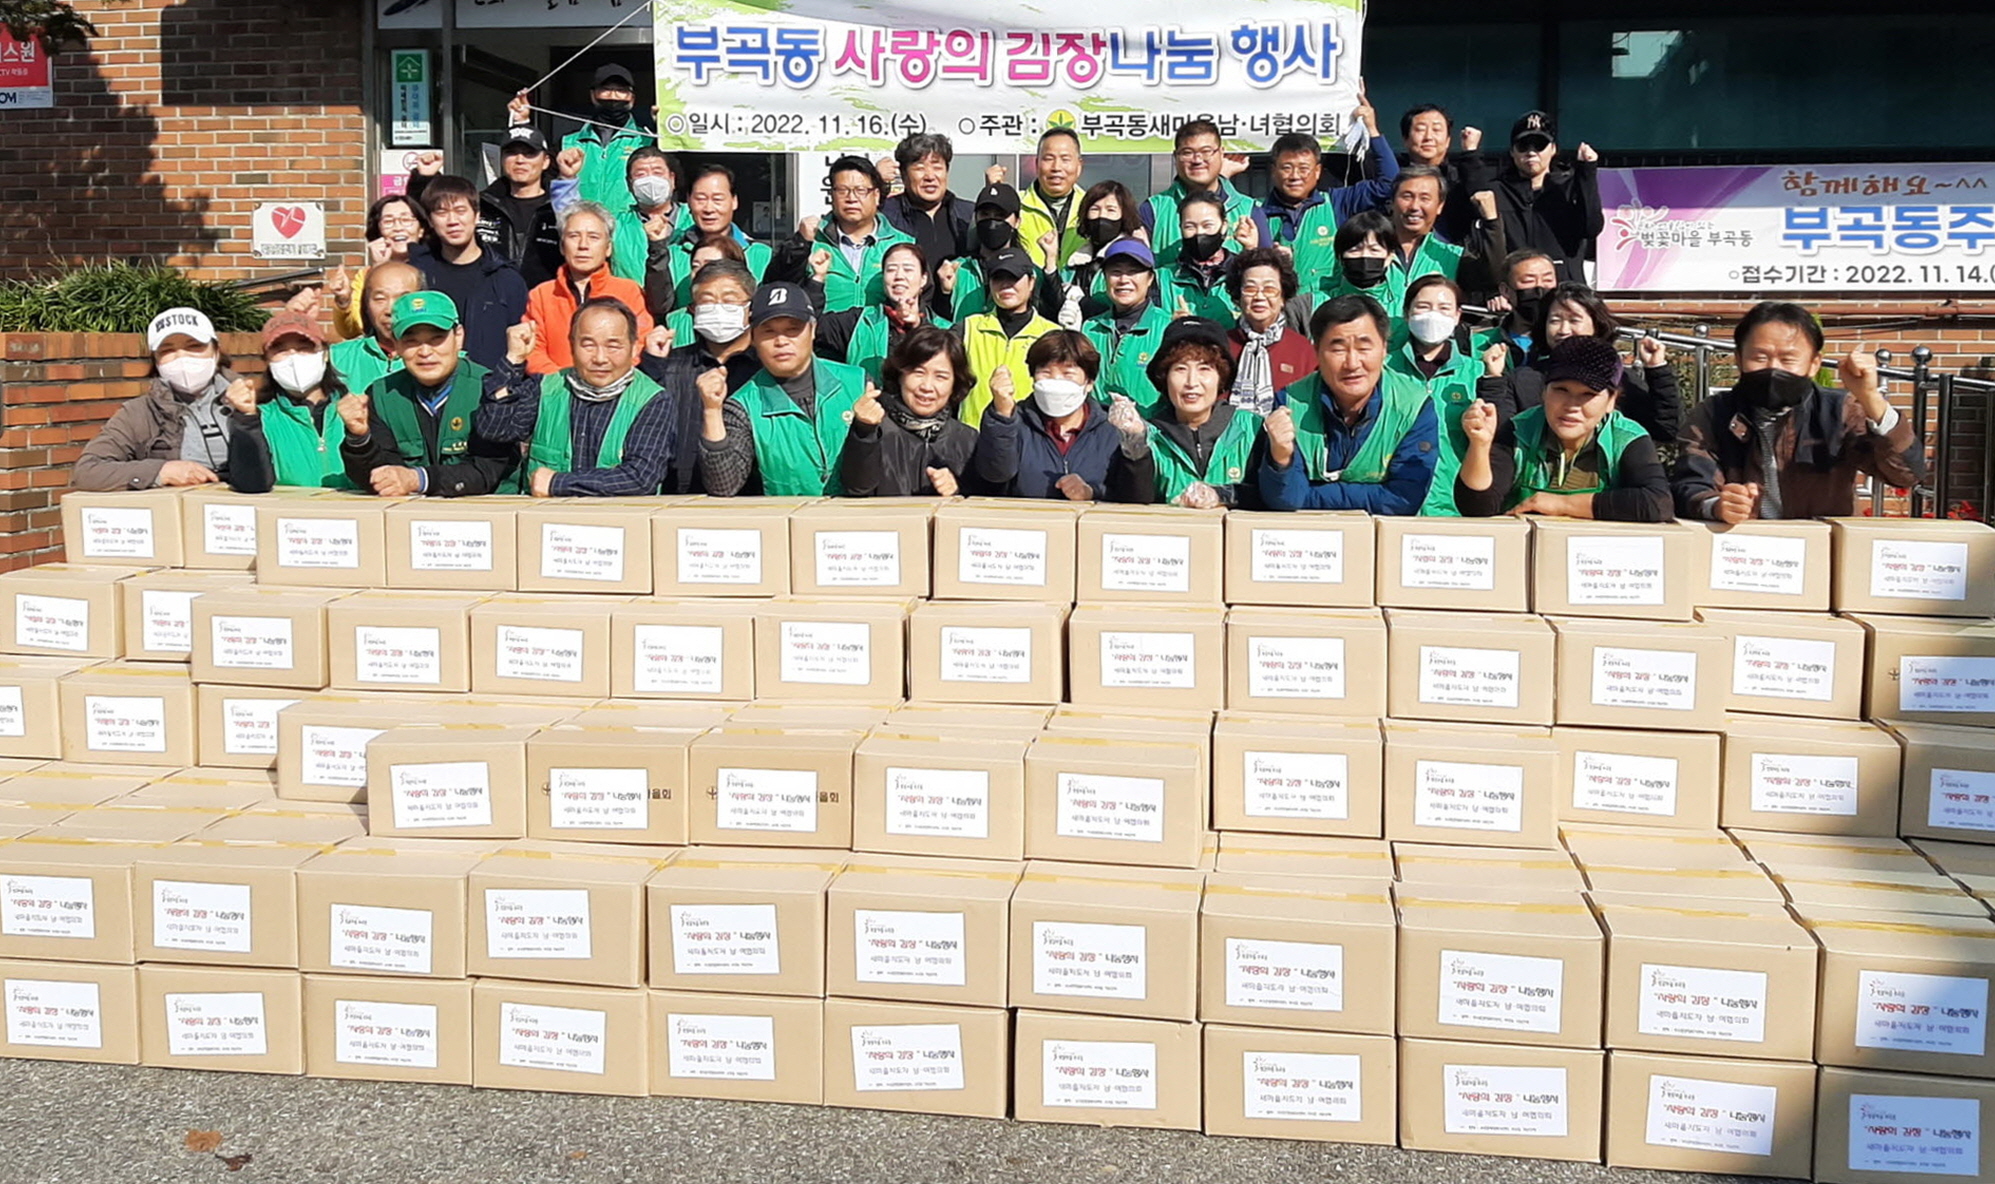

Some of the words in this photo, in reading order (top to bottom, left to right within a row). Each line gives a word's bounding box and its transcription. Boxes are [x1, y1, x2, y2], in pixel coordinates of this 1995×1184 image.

[0, 40, 36, 63] 스원
[677, 26, 820, 84] 부곡동
[835, 29, 989, 84] 사랑의
[1231, 22, 1338, 83] 행사
[689, 113, 730, 135] 일시
[751, 114, 810, 135] 2022.
[819, 114, 850, 135] 11.
[979, 114, 1023, 136] 주관
[1641, 231, 1702, 247] 벚꽃마을
[1707, 231, 1753, 247] 부곡동
[1741, 265, 1827, 284] 접수기간
[1846, 265, 1913, 284] 2022.
[1920, 265, 1950, 283] 11.
